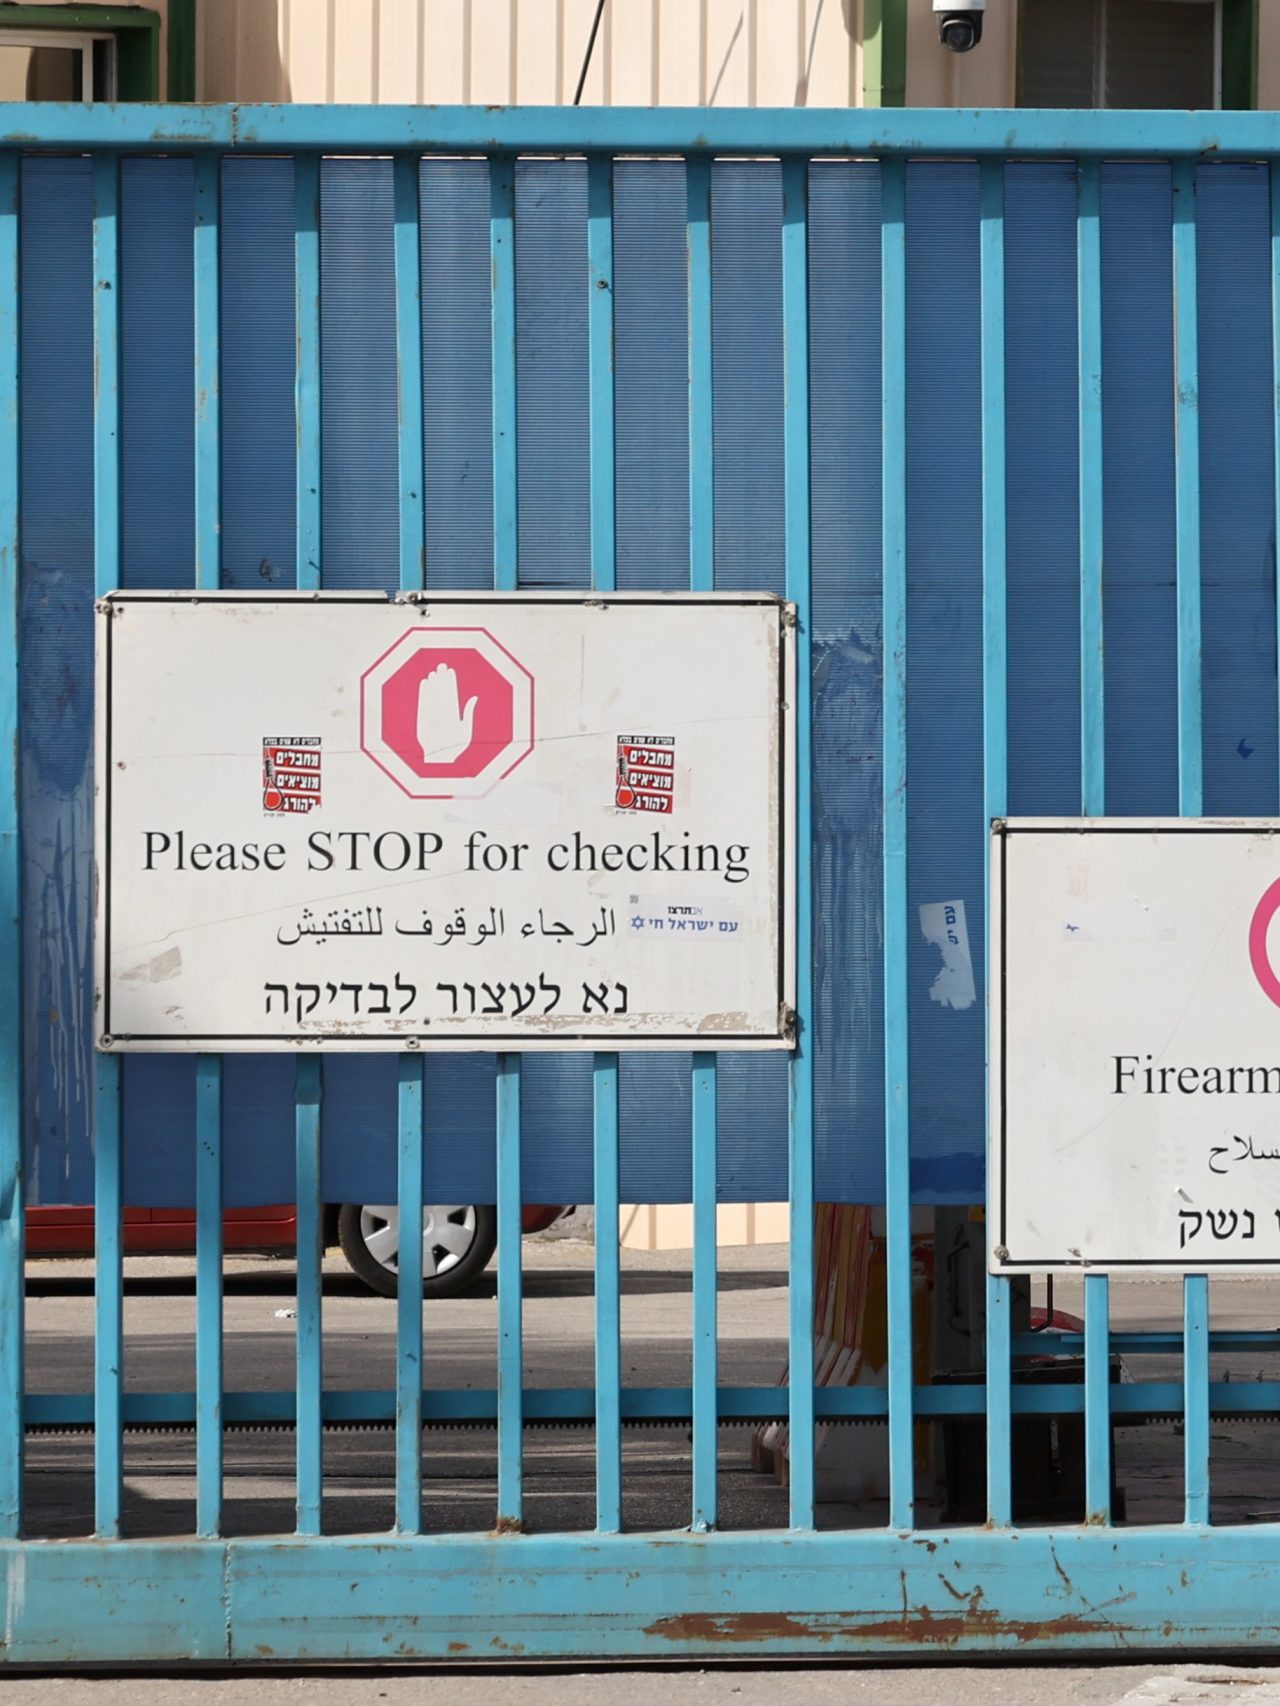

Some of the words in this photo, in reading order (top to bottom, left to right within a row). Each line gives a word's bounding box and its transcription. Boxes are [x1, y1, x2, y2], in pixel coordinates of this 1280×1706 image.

[276, 751, 319, 767] מחבלים
[629, 749, 672, 767] מחבלים
[276, 774, 319, 790] מוציאים
[629, 772, 672, 789] מוציאים
[635, 795, 668, 811] להורג
[141, 830, 286, 871] Please
[308, 831, 443, 871] STOP
[465, 830, 529, 872] for
[547, 831, 750, 884] checking
[276, 906, 383, 946] للتفتيش
[648, 918, 664, 930] חי
[667, 917, 714, 931] ישראל
[944, 905, 956, 926] עם
[395, 907, 505, 946] الوقوف
[520, 906, 615, 947] الرجاء
[718, 921, 738, 933] עם
[264, 971, 417, 1024] לבדיקה
[435, 971, 561, 1017] לעצור
[582, 982, 628, 1014] נא
[1178, 1208, 1255, 1249] נשק
